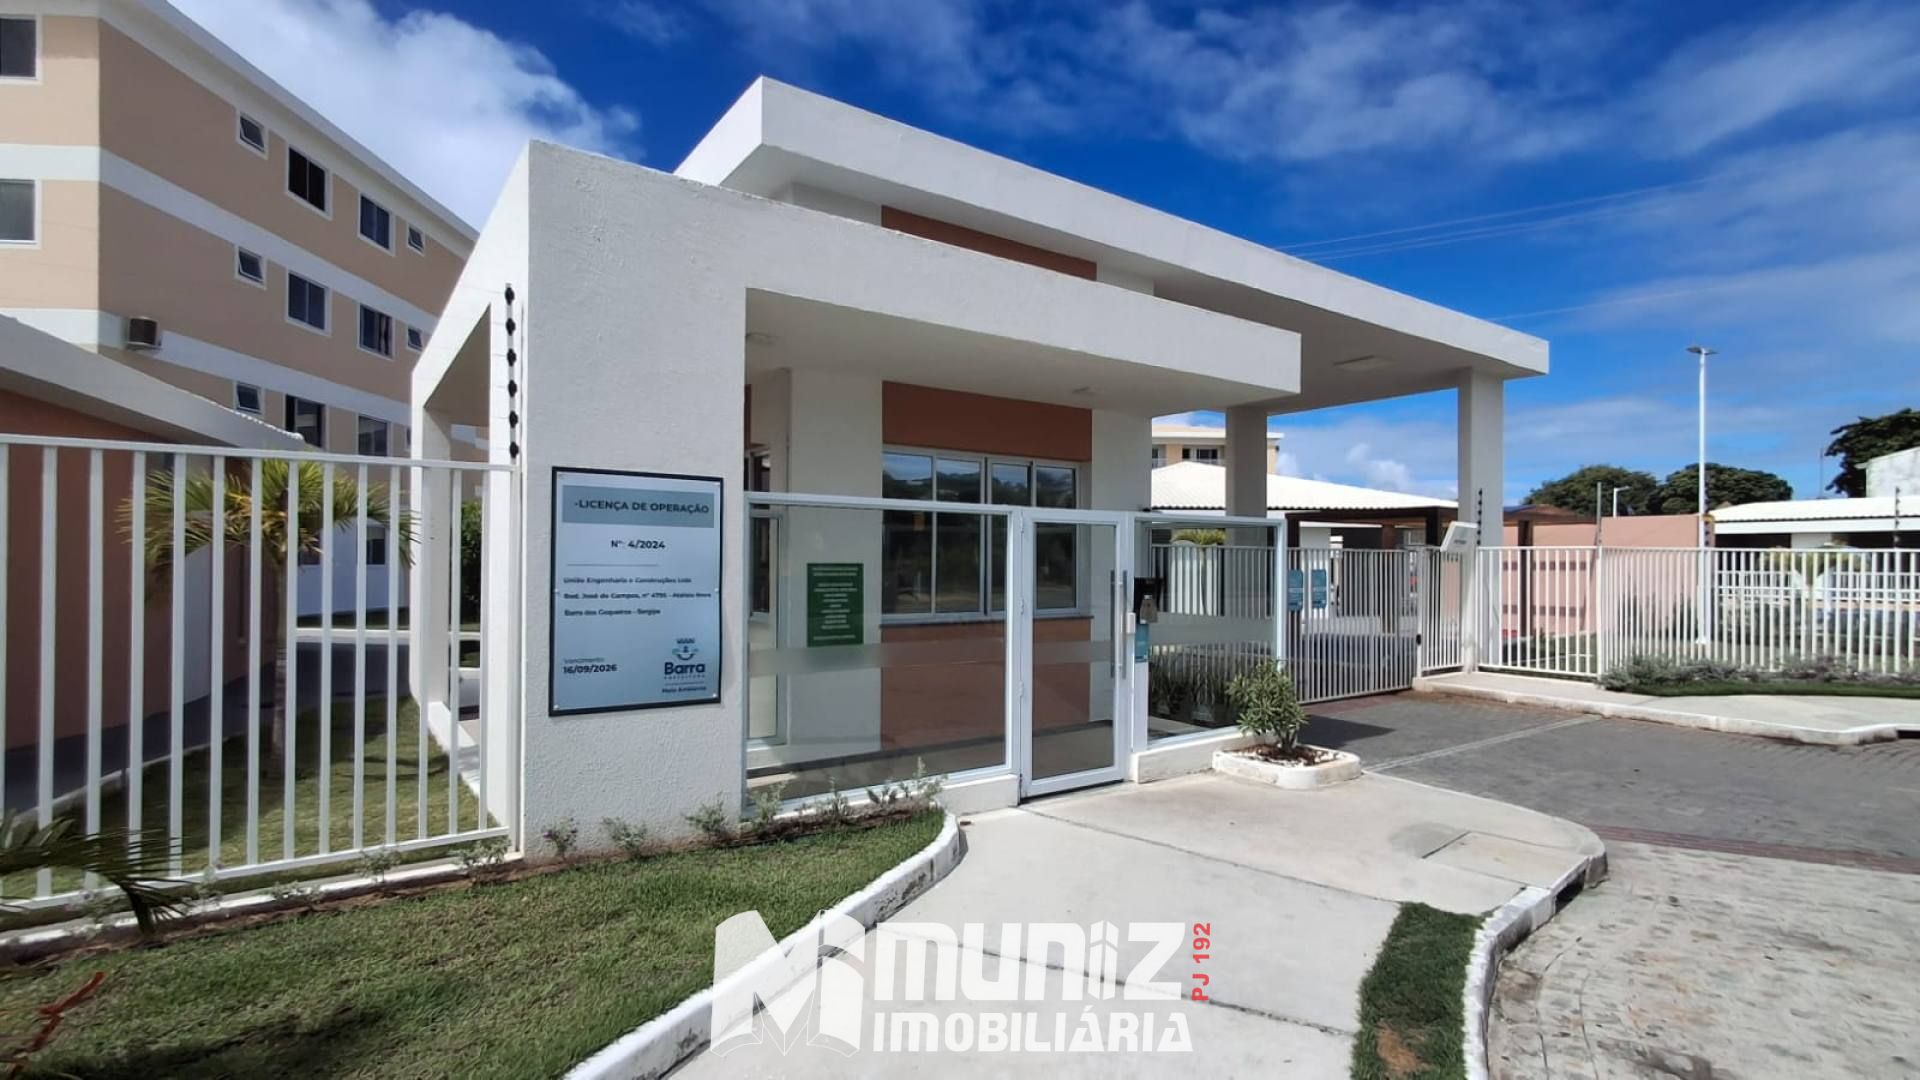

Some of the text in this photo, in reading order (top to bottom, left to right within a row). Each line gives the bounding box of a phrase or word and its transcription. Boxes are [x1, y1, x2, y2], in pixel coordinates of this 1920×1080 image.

[632, 502, 647, 511] DE
[650, 502, 710, 514] OPERAÇÃO
[628, 539, 666, 549] 4/2024
[563, 664, 618, 673] 16/09/2026
[664, 662, 706, 675] Barra
